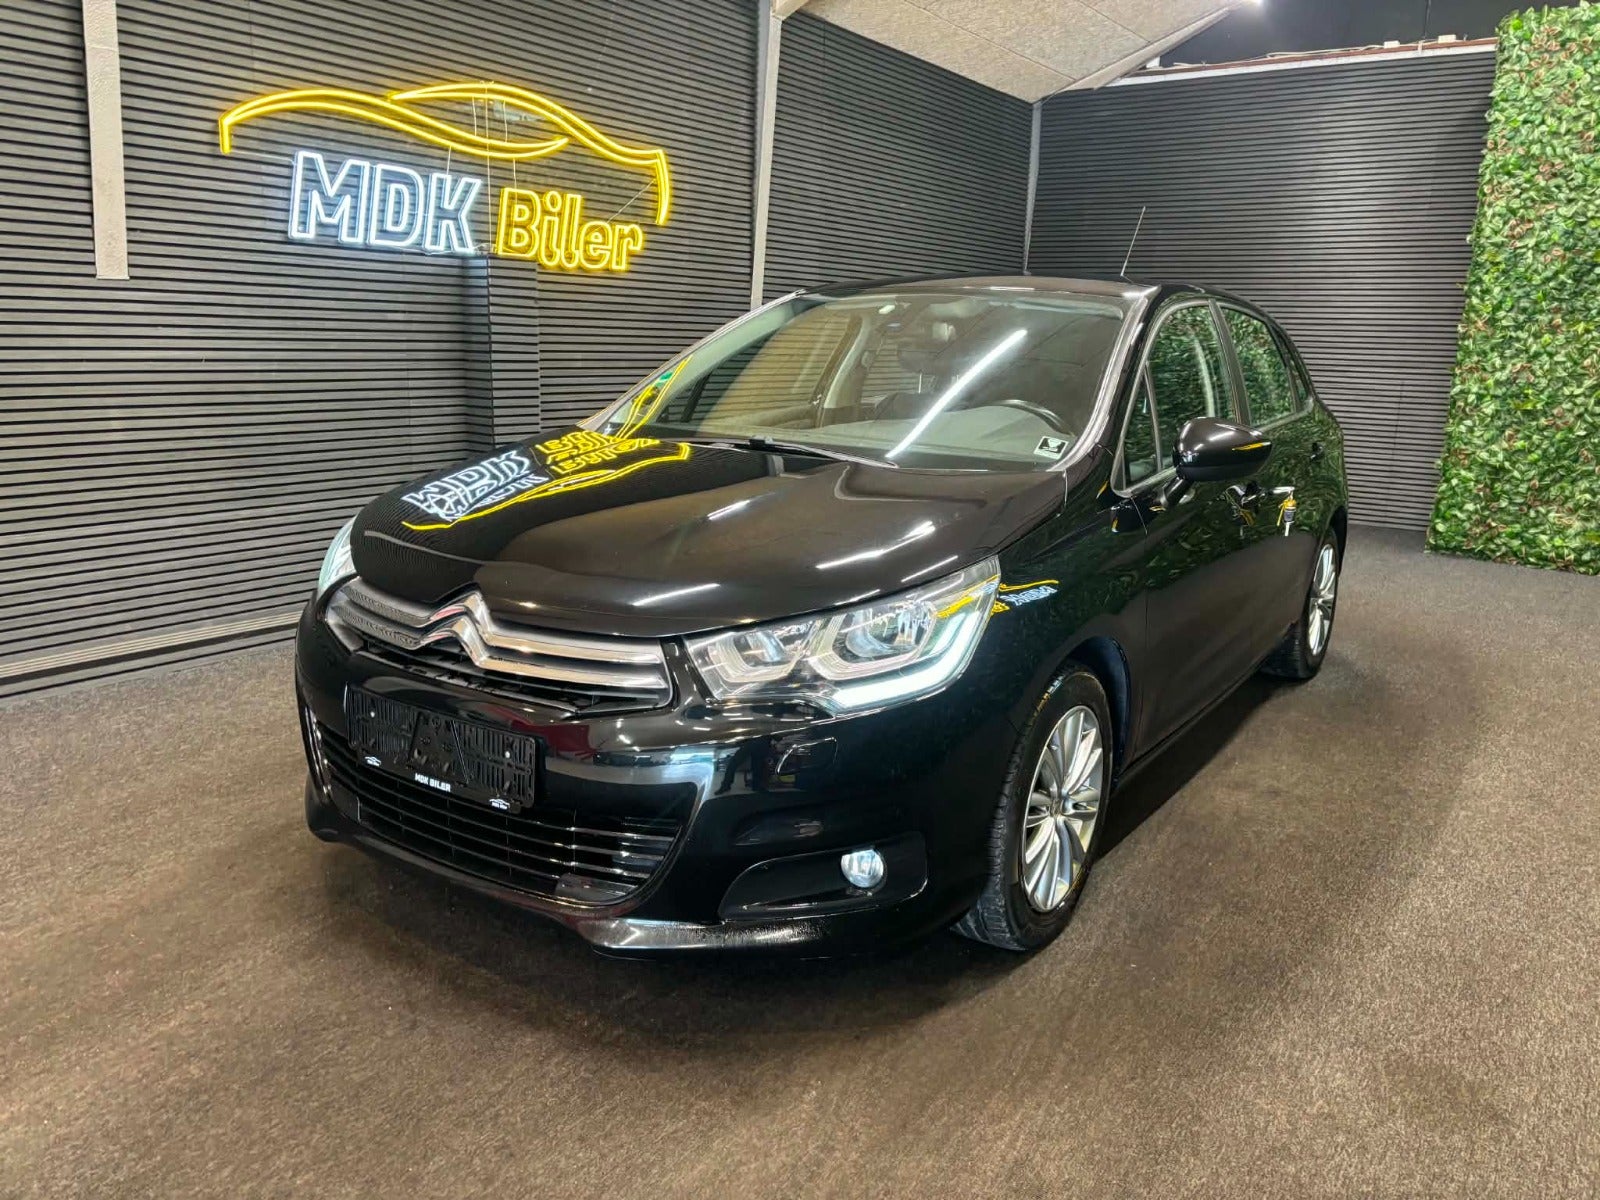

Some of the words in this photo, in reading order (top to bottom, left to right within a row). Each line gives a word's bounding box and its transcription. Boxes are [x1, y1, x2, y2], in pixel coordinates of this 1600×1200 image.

[289, 151, 481, 254] MDK
[497, 187, 643, 270] Biler
[429, 778, 451, 792] BILER
